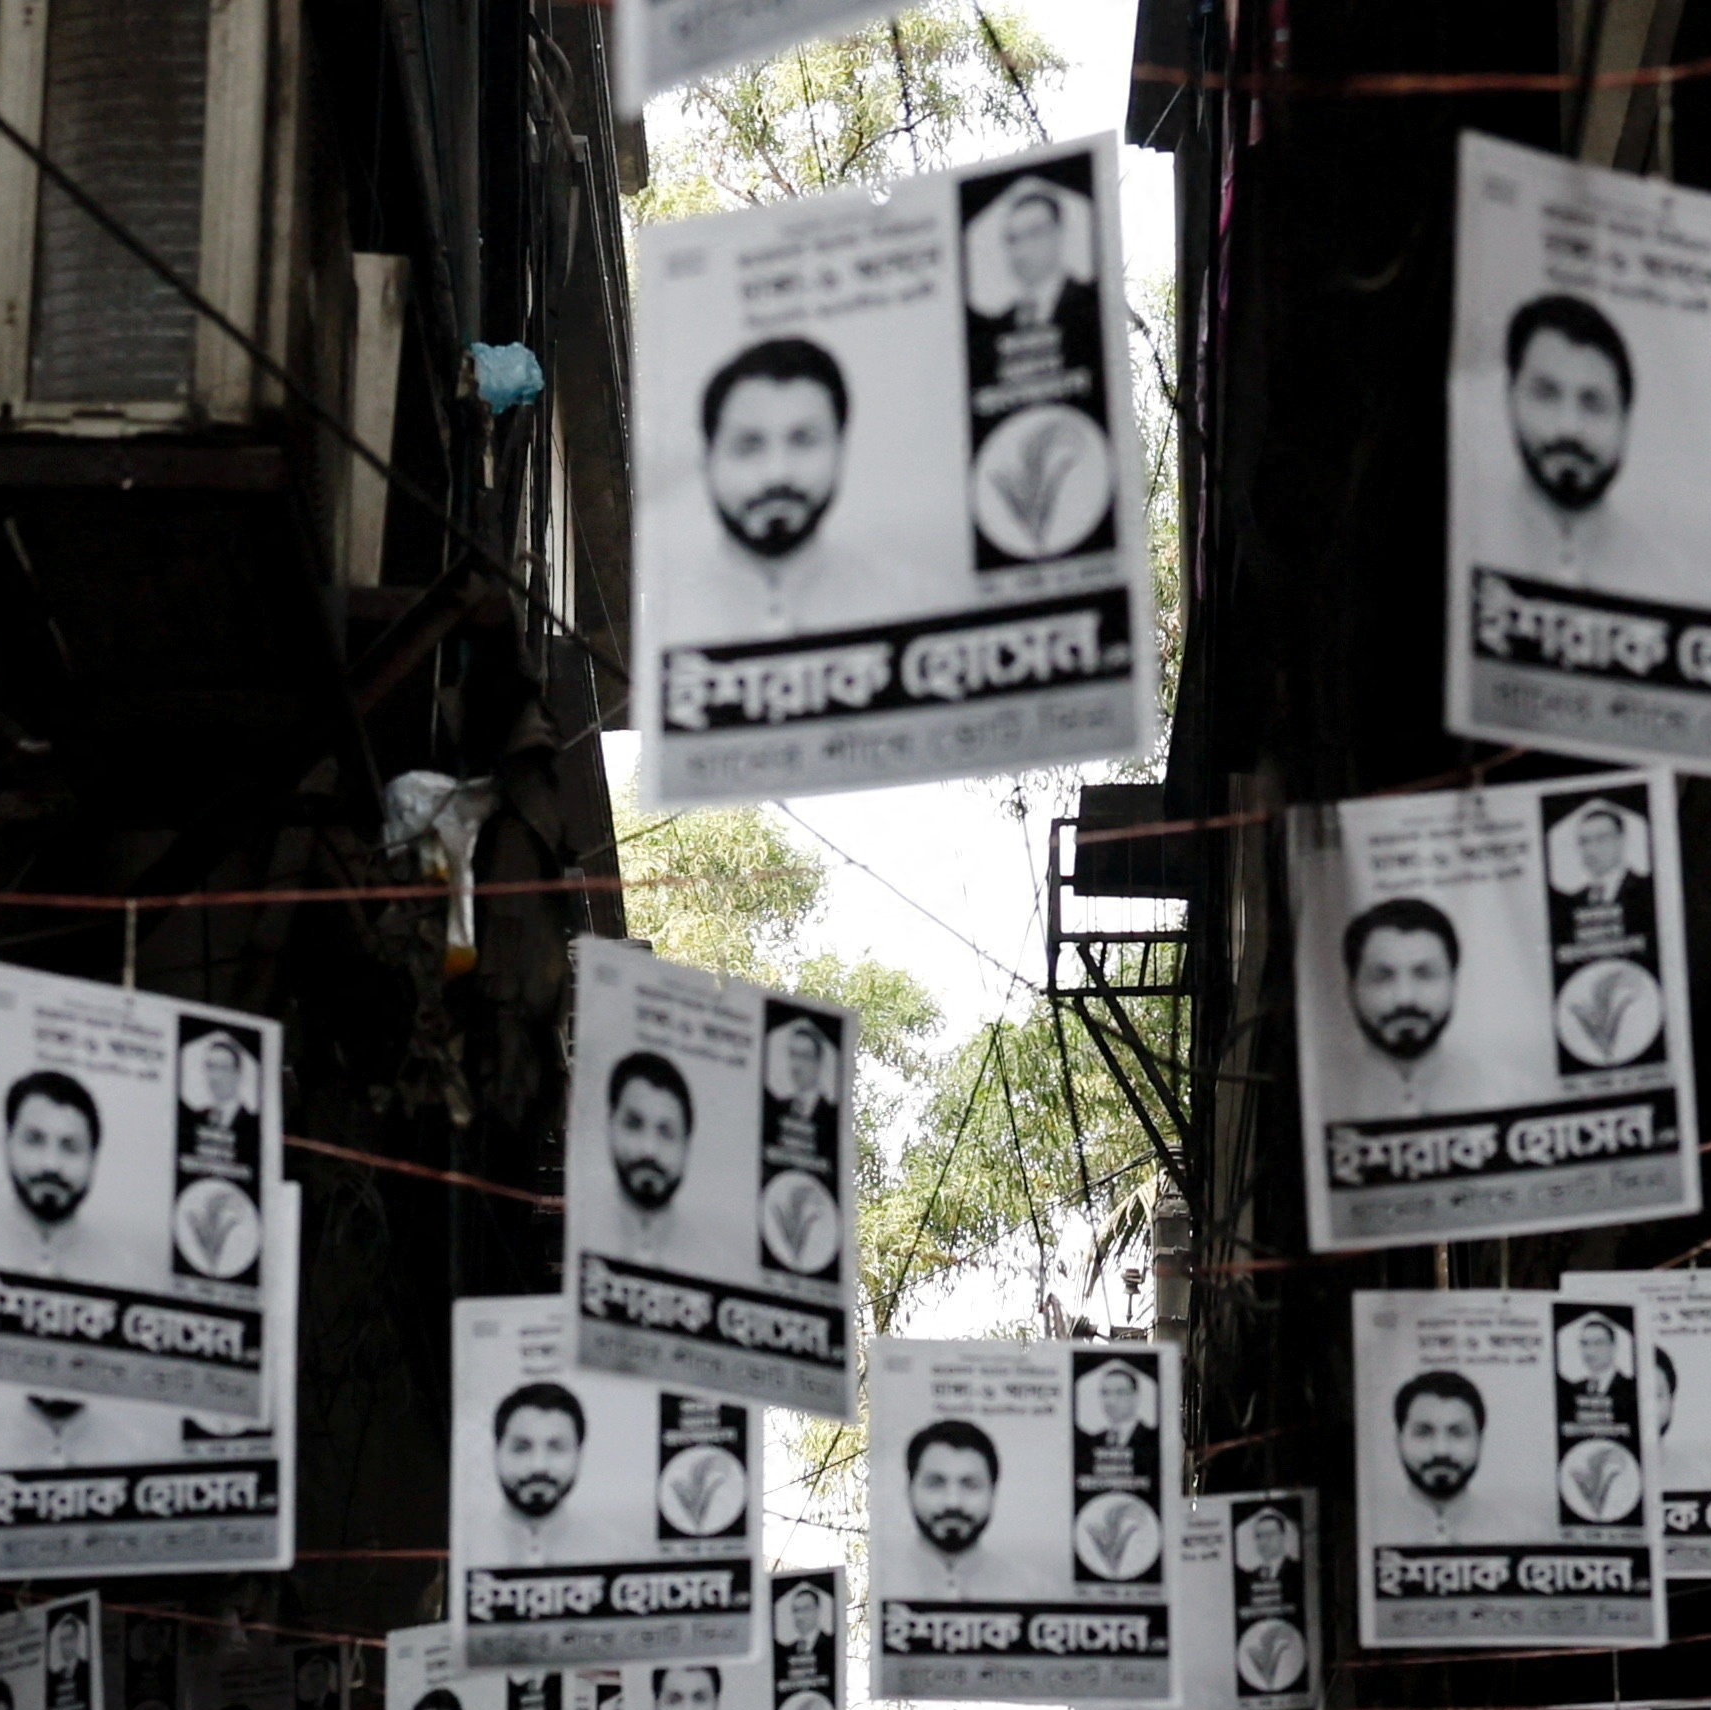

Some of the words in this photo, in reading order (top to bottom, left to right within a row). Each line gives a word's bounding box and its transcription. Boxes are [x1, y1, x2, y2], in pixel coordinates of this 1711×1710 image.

[1475, 576, 1672, 674] ইশরাক
[664, 643, 894, 730] ইশরাক
[901, 609, 1103, 701] হোসেন
[1328, 1123, 1501, 1188] ইশরাক
[1504, 1103, 1657, 1169] হোসেন
[122, 1300, 245, 1360] হোসেন
[581, 1260, 718, 1335] ইশরাক
[717, 1298, 833, 1363] হোসেন
[133, 1463, 261, 1518] হোসেন
[467, 1572, 606, 1621] ইশরাক
[609, 1570, 734, 1614] হোসেন
[1377, 1551, 1510, 1598] ইশরাক
[1514, 1551, 1633, 1595] হোসেন
[883, 1603, 1023, 1658] ইশরাক
[1026, 1608, 1151, 1656] হোসেন
